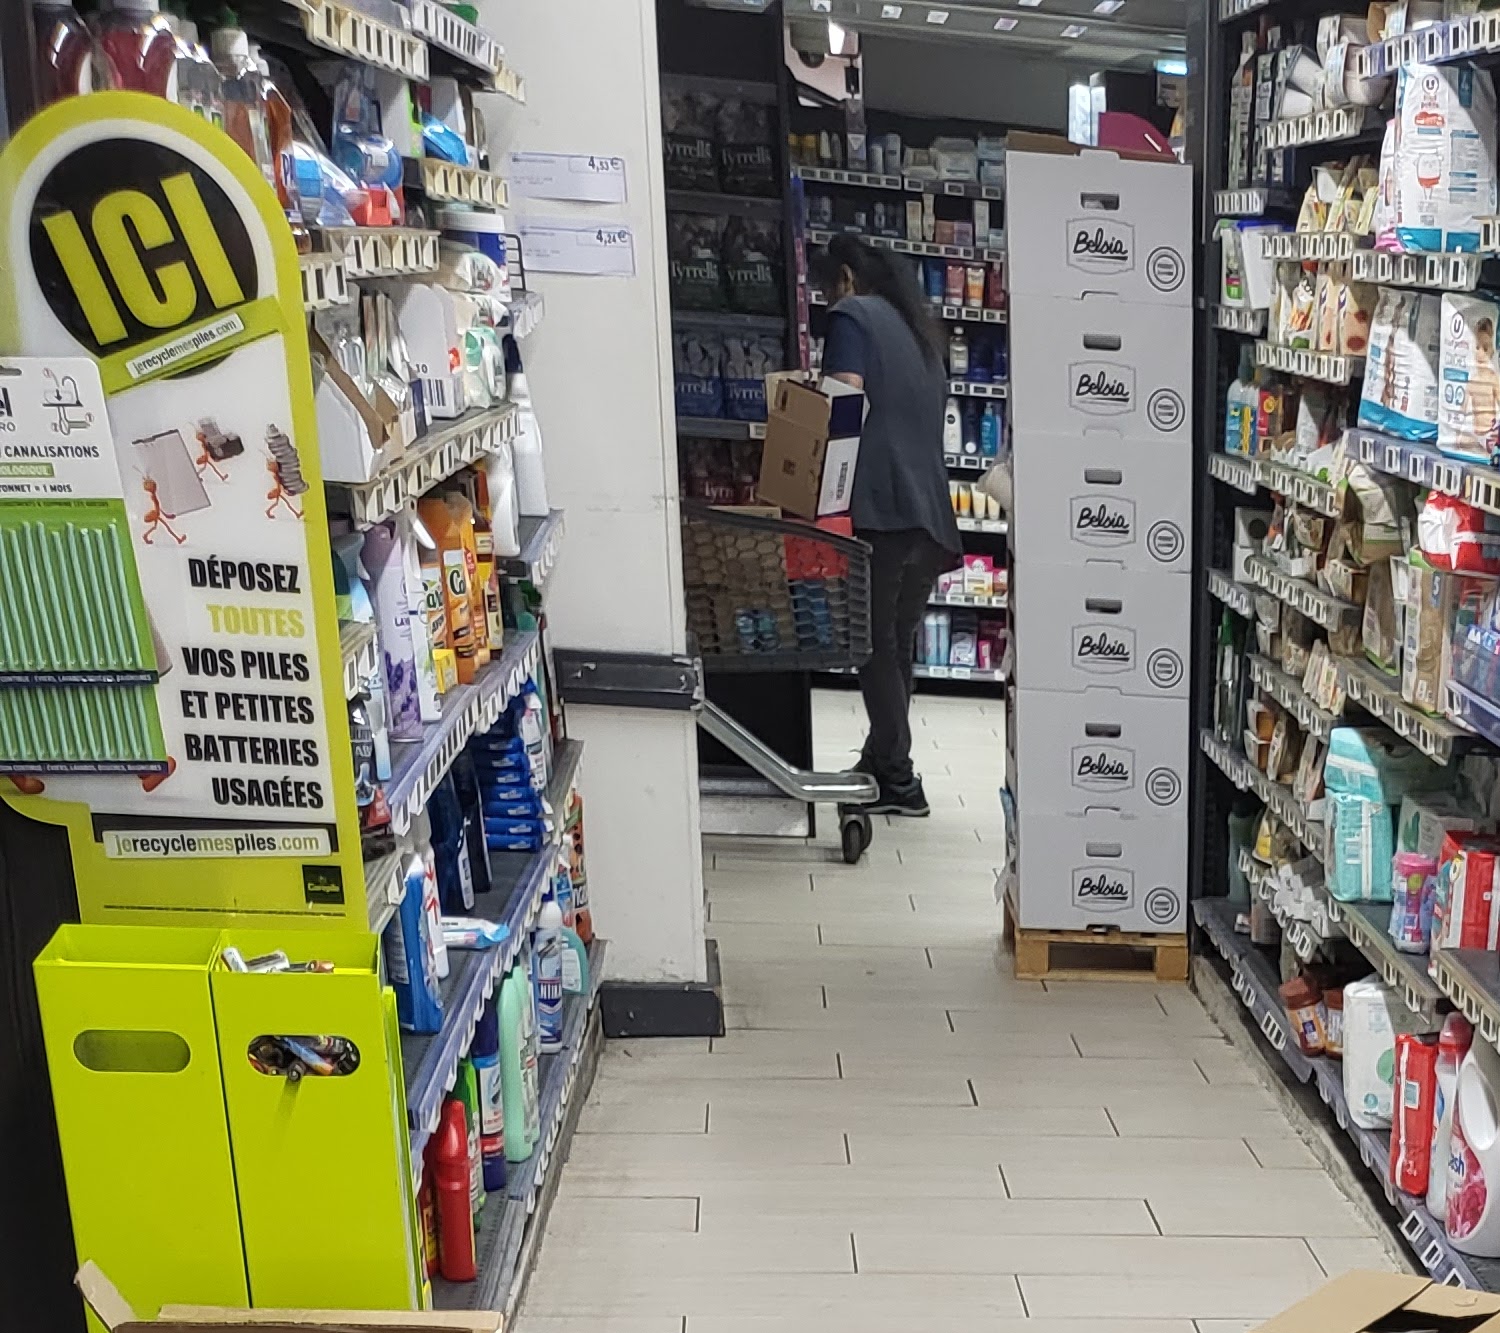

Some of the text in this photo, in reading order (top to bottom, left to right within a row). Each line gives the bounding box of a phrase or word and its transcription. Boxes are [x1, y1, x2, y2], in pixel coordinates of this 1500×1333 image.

[42, 171, 245, 346] ICI
[4, 445, 100, 458] CANALISATIONS
[188, 555, 301, 593] DÉPOSEZ
[207, 604, 305, 637] TOUTES
[182, 647, 310, 682] VOS PILES
[180, 690, 314, 724] ET PETITES
[184, 734, 319, 767] BATTERIES
[211, 774, 324, 809] USAGÉES
[115, 833, 320, 856] jerecyclemespiles.com
